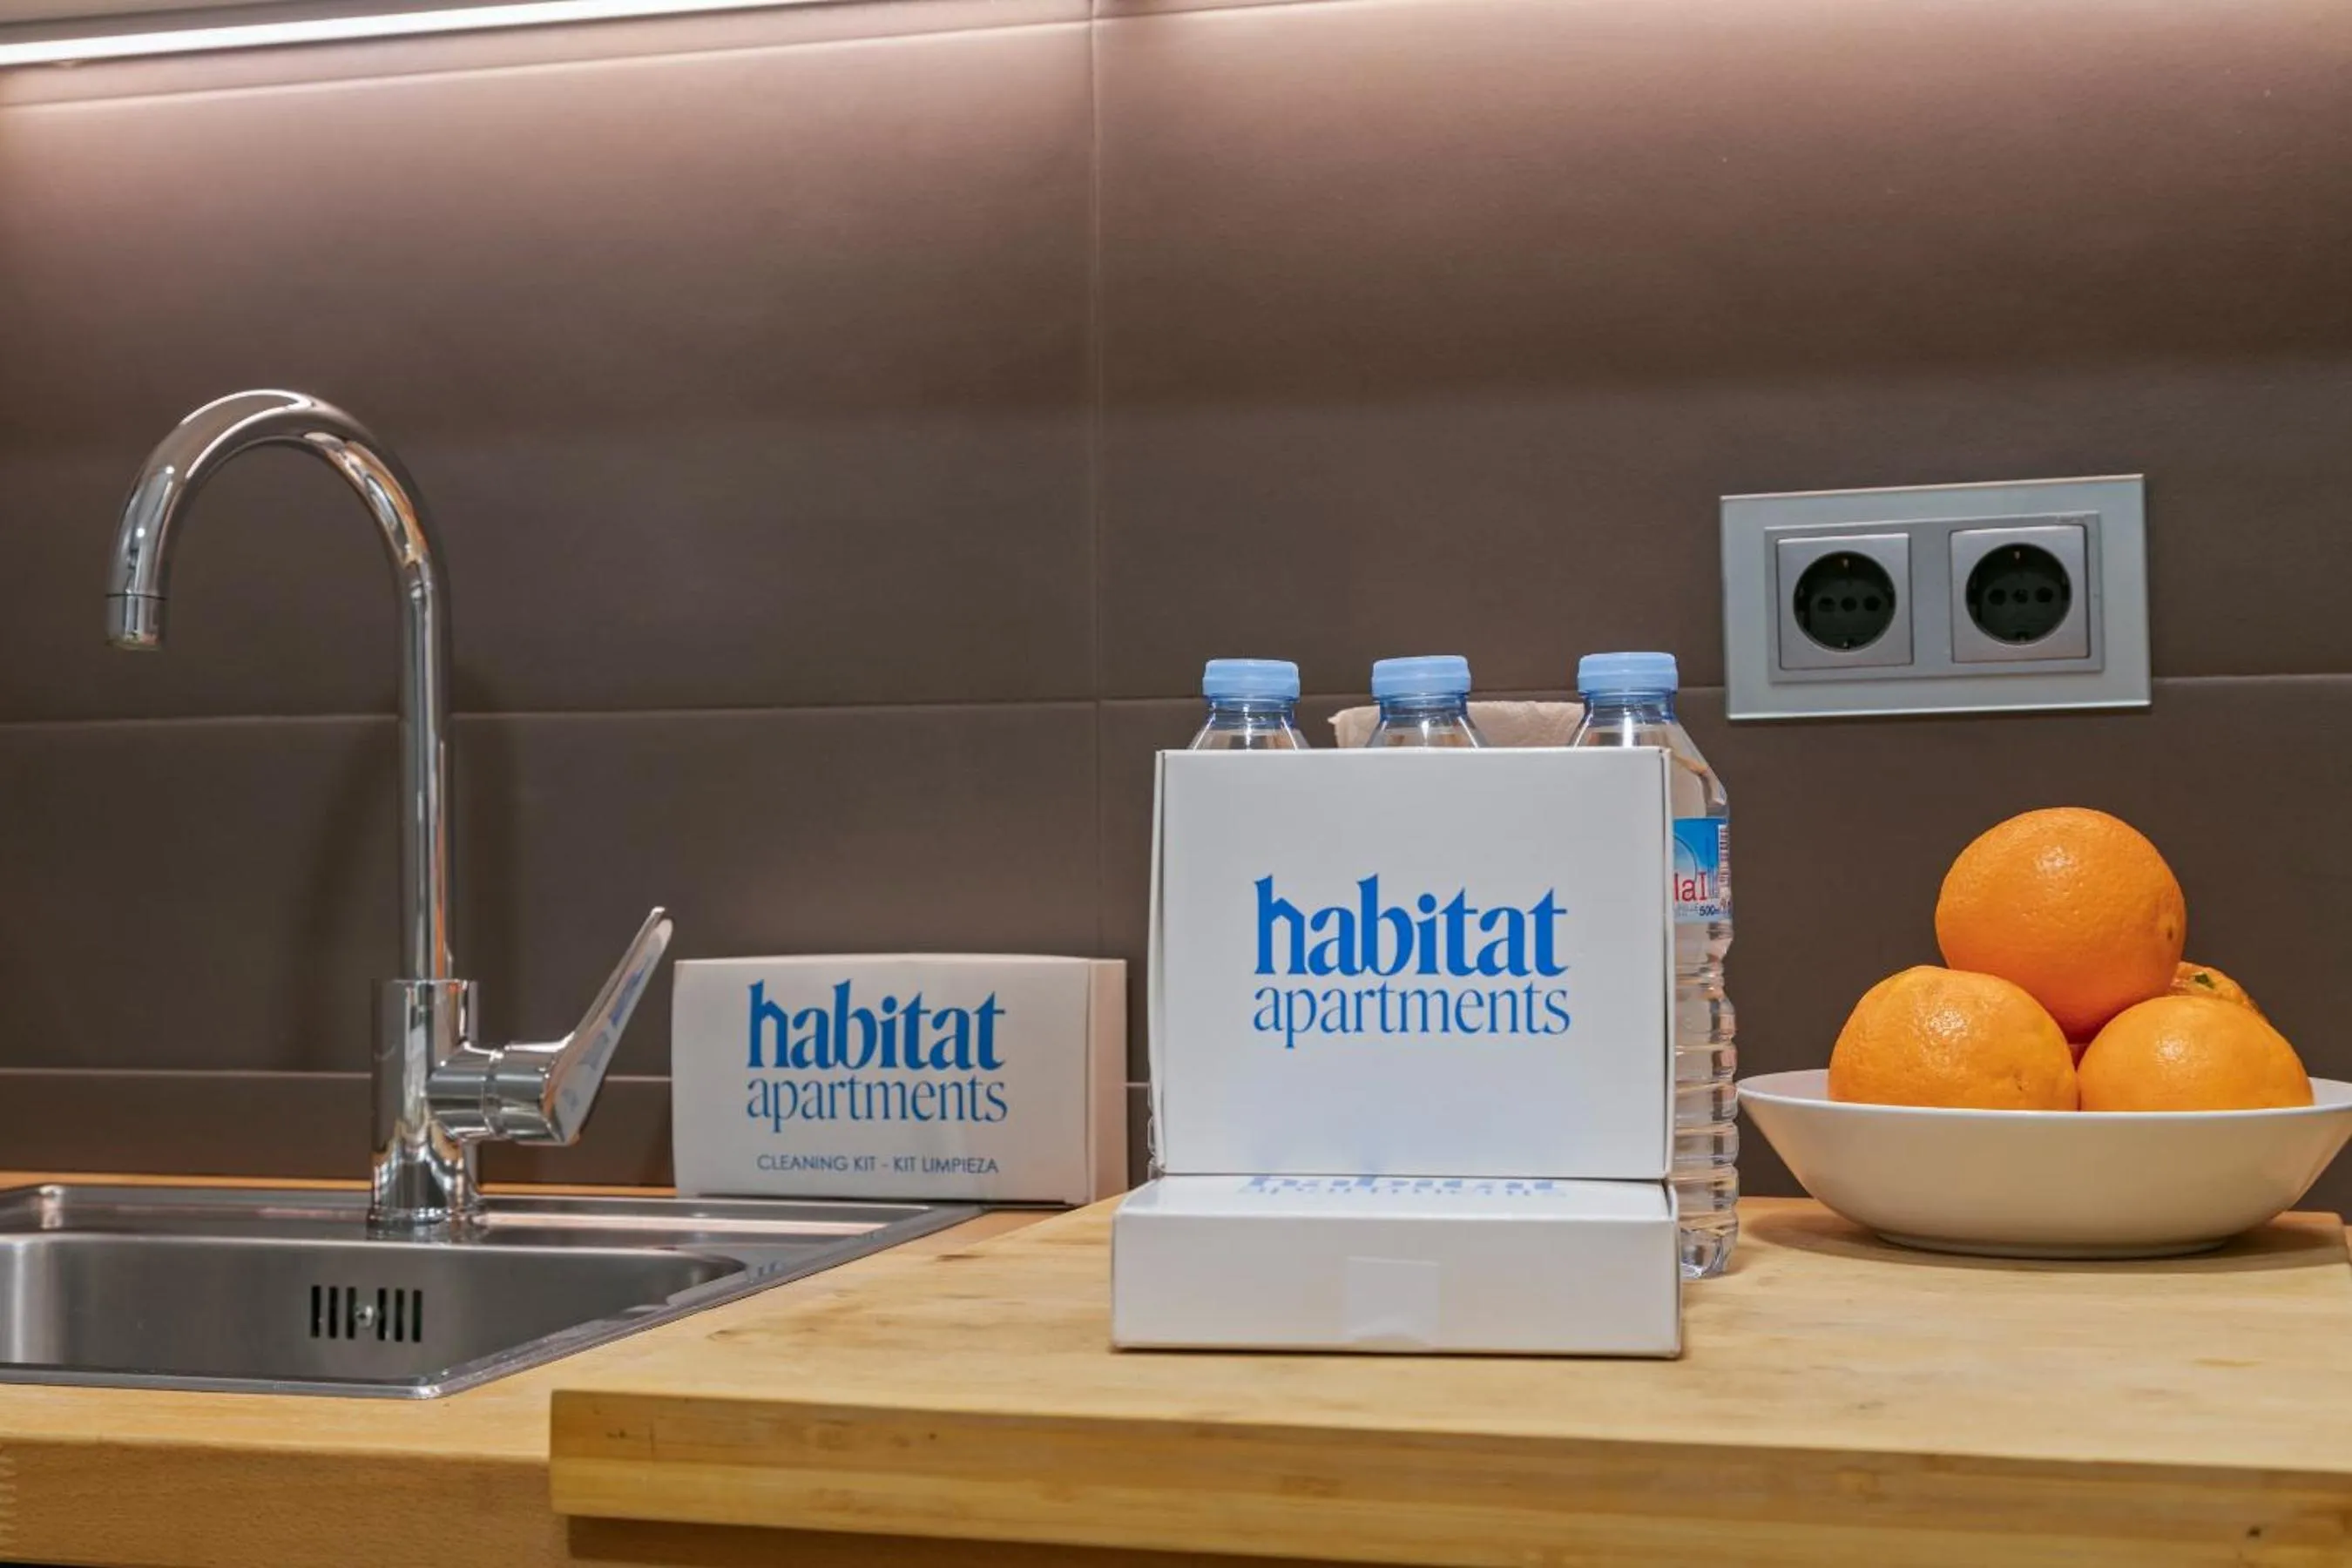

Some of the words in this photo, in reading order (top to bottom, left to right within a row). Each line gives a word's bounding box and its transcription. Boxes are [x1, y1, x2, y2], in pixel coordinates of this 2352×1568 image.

[1254, 874, 1570, 977] habitat
[747, 979, 1006, 1071] habitat
[1254, 980, 1571, 1050] apartments
[747, 1074, 1009, 1133] apartments
[757, 1154, 848, 1172] CLEANING
[854, 1156, 876, 1172] KIT
[893, 1157, 917, 1172] KIT
[922, 1157, 999, 1173] LIMPIEZA
